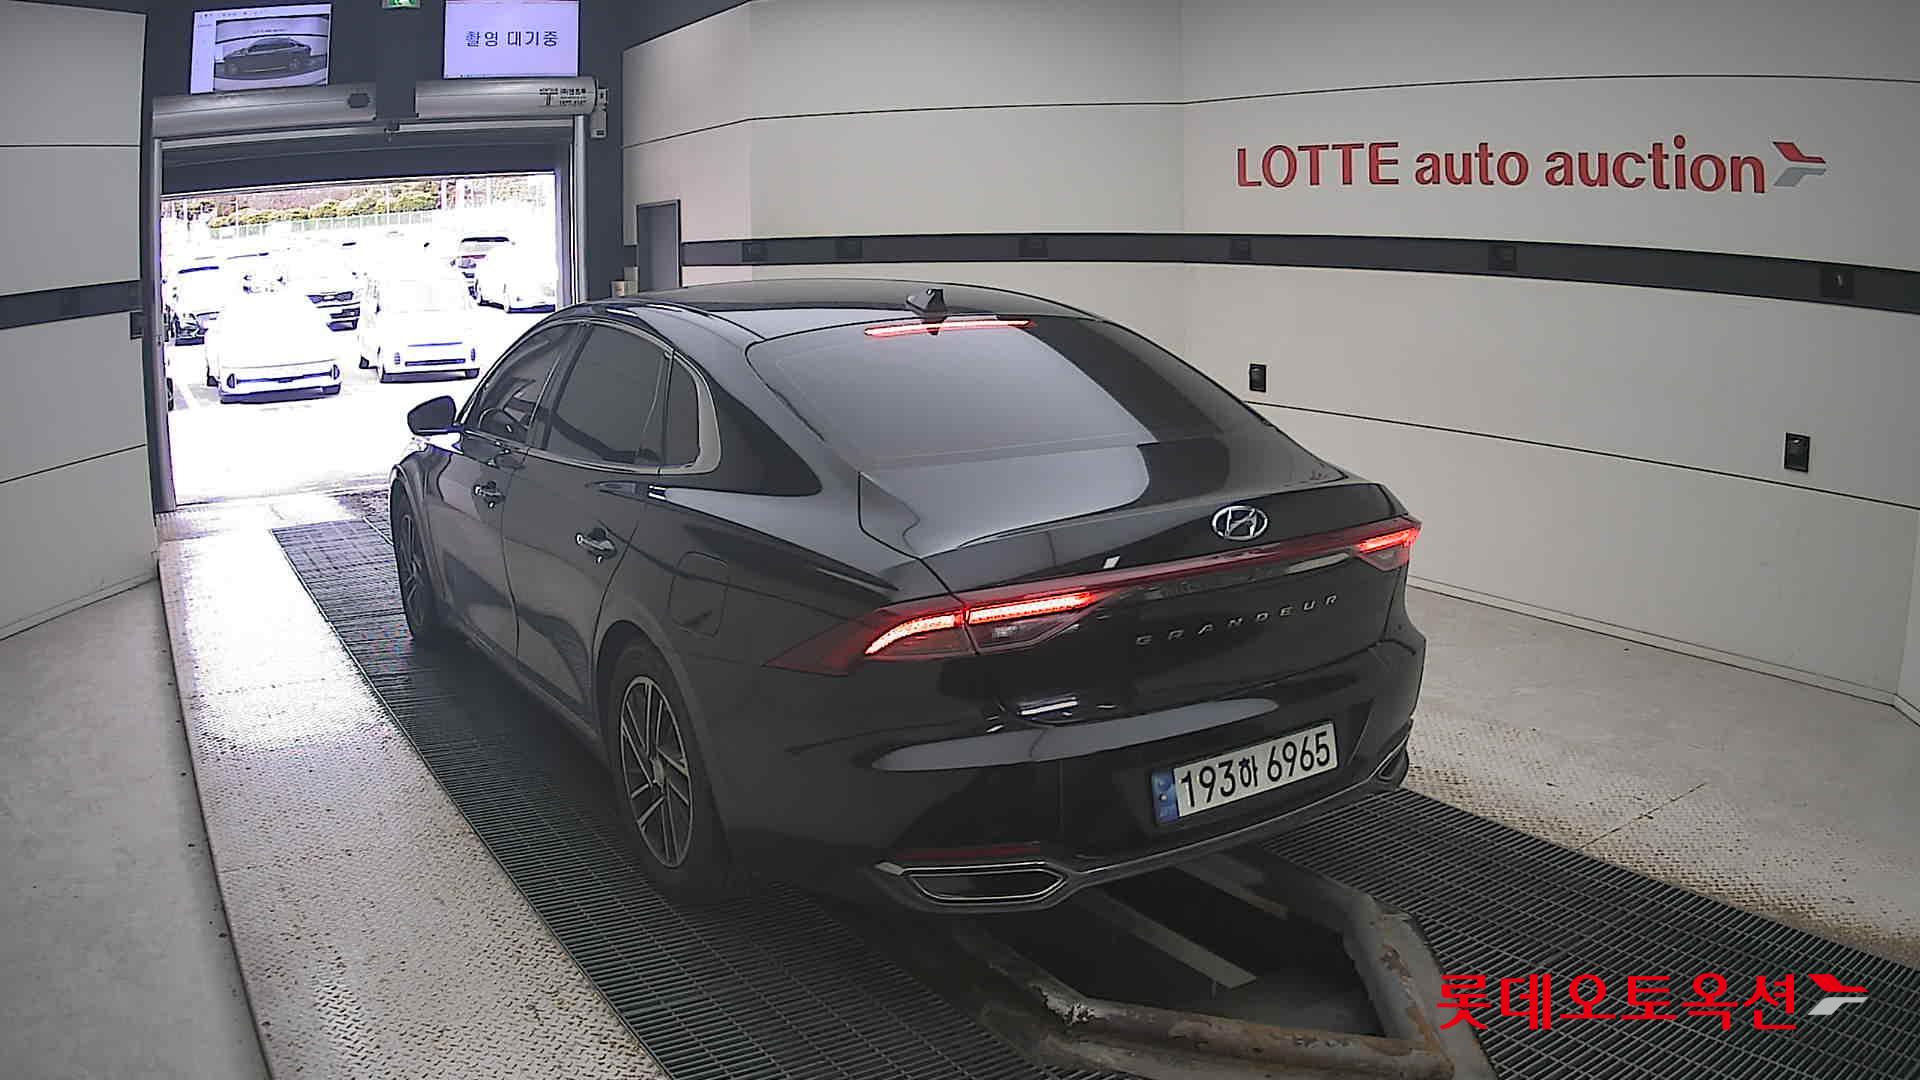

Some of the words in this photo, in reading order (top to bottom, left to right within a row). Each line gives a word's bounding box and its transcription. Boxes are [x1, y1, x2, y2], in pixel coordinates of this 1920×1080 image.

[507, 30, 559, 47] 대기중
[1236, 141, 1400, 188] LOTTE
[1414, 142, 1530, 188] auto
[1544, 134, 1766, 194] auction
[1135, 594, 1338, 646] GRANDEUR
[1180, 755, 1259, 808] 193하
[1266, 731, 1330, 782] 6965
